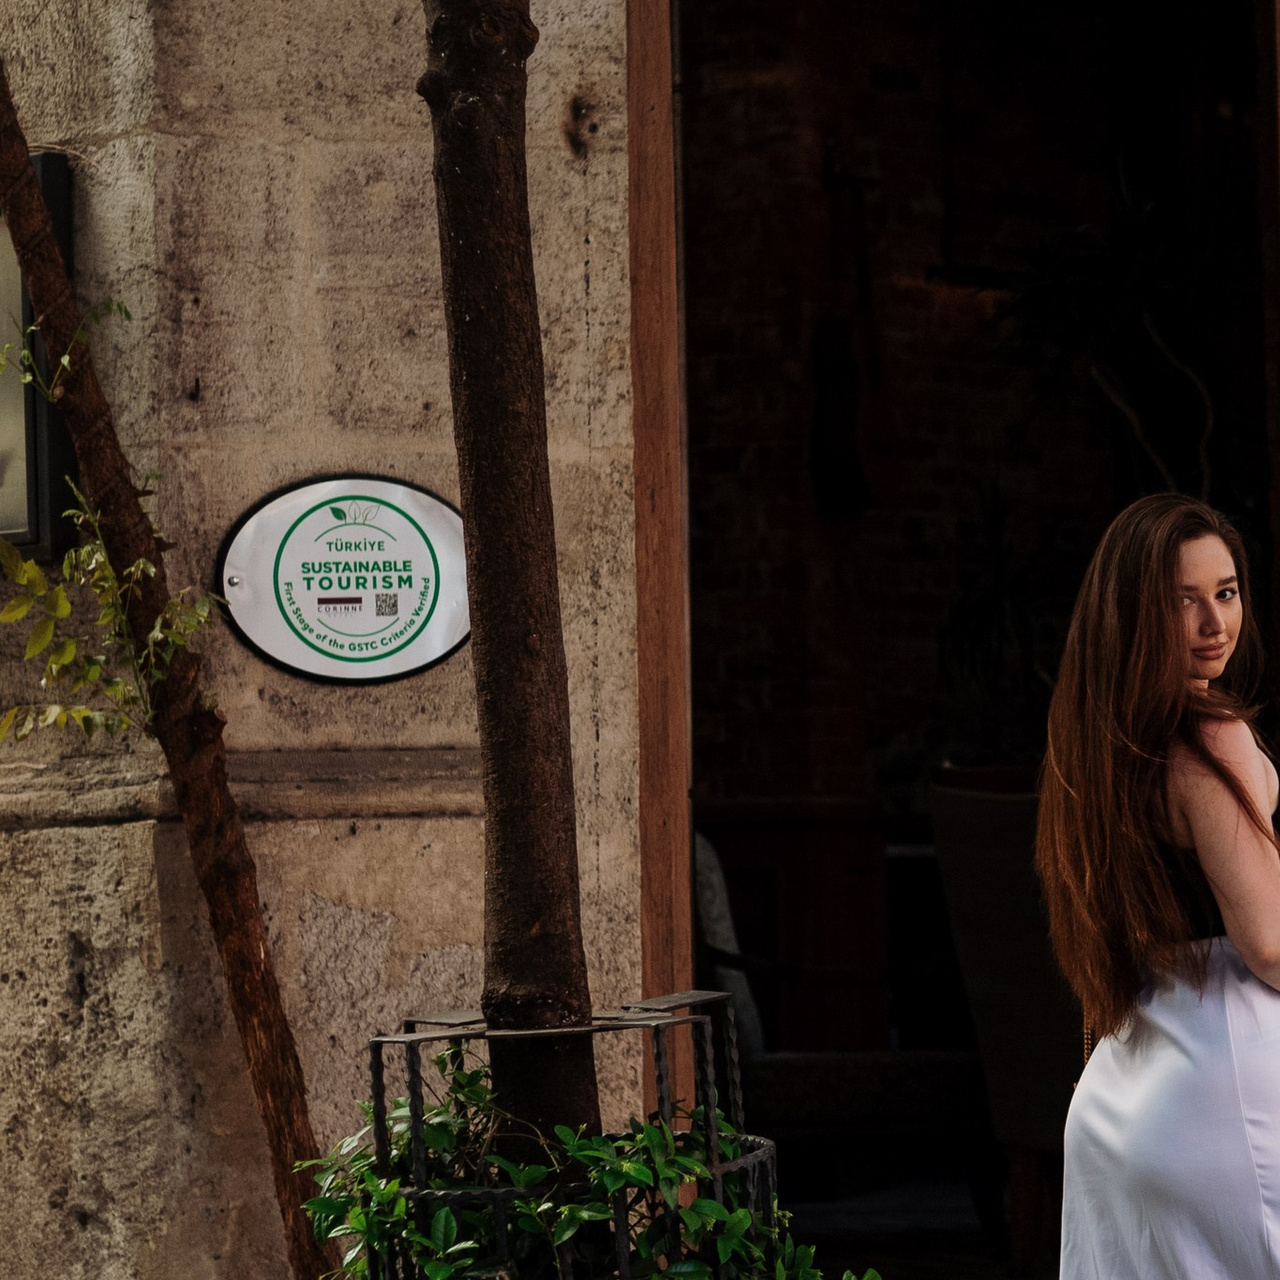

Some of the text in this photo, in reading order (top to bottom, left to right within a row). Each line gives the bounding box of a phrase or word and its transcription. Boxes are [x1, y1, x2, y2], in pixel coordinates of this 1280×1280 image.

[325, 537, 386, 552] TÜRKİYE
[300, 560, 413, 574] SUSTAINABLE
[302, 575, 413, 591] TOURISM
[284, 577, 430, 651] First Stage of the GSTC Criteria Verified
[317, 604, 363, 613] CORINNE
